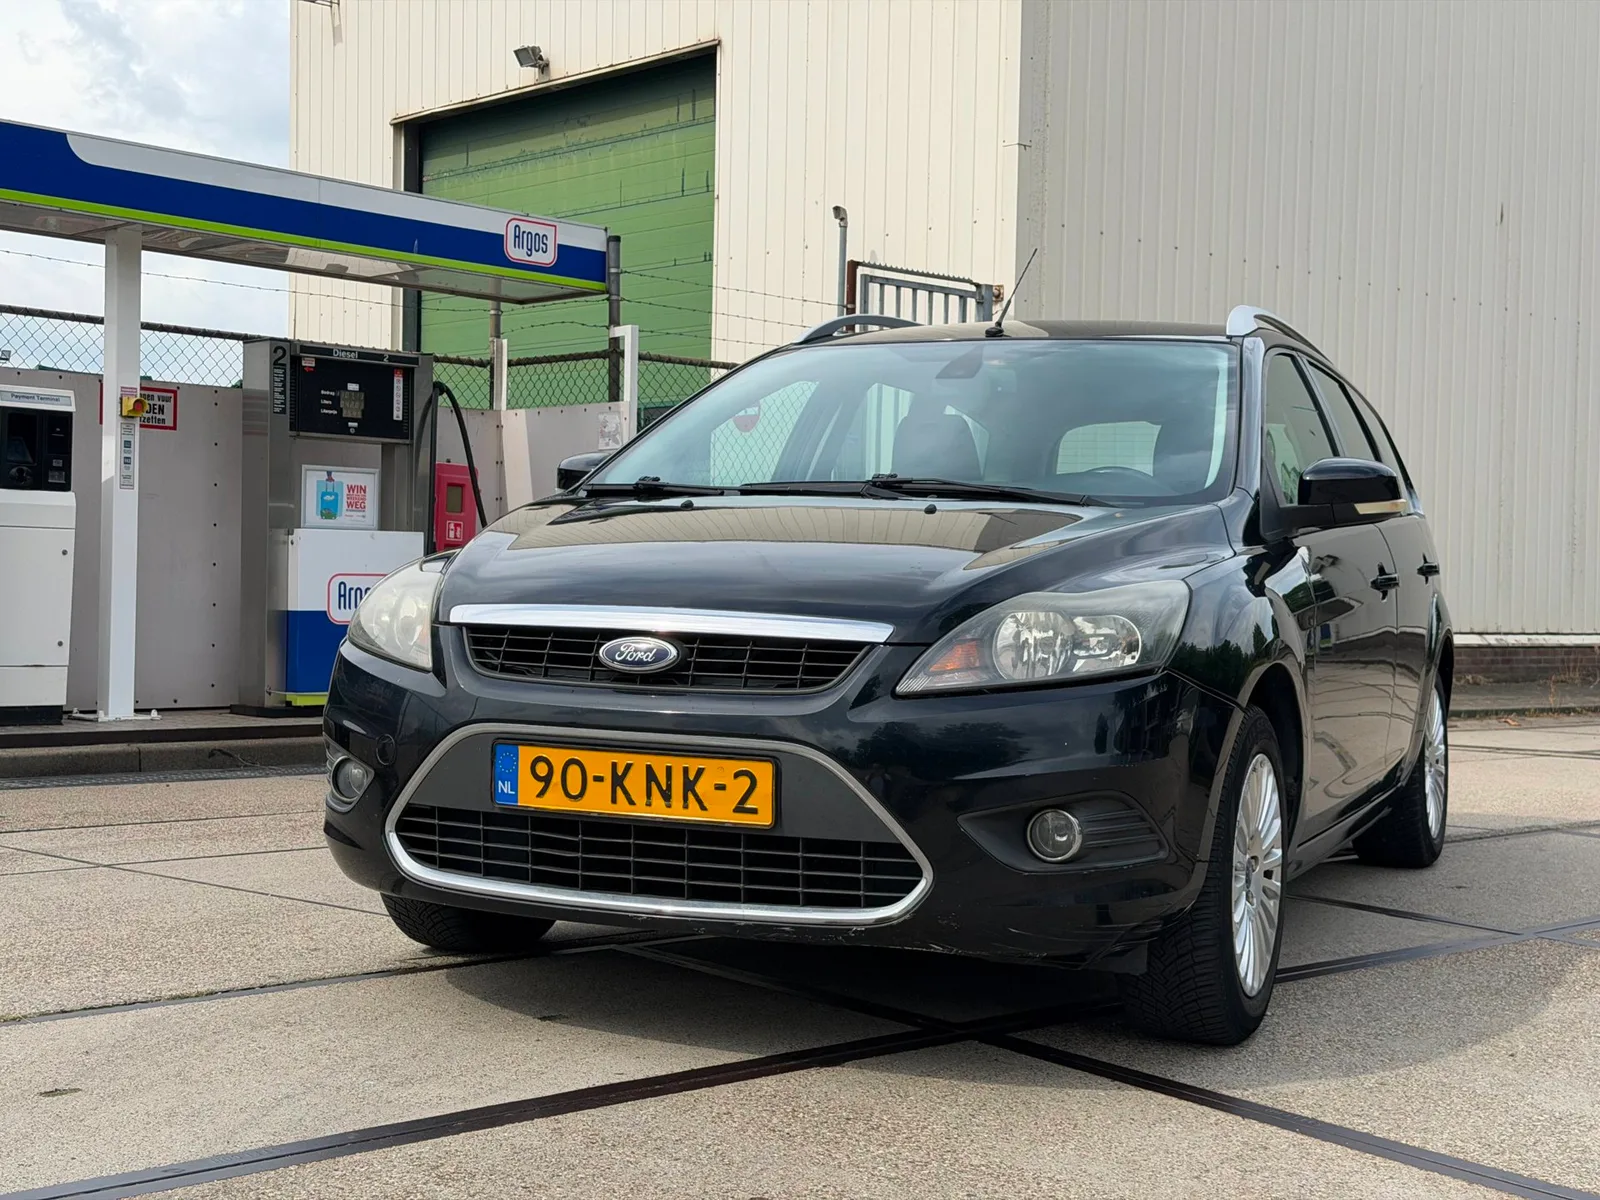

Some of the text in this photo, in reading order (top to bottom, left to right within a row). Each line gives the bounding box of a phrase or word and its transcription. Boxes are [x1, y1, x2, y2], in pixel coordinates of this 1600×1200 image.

[513, 224, 548, 257] Argos
[273, 345, 287, 366] 2
[332, 348, 389, 362] Diesel 2
[346, 484, 367, 494] WIN
[346, 500, 366, 510] WEG
[615, 642, 657, 663] Ford
[498, 780, 515, 795] NL
[529, 755, 759, 815] 90-KNK-2
